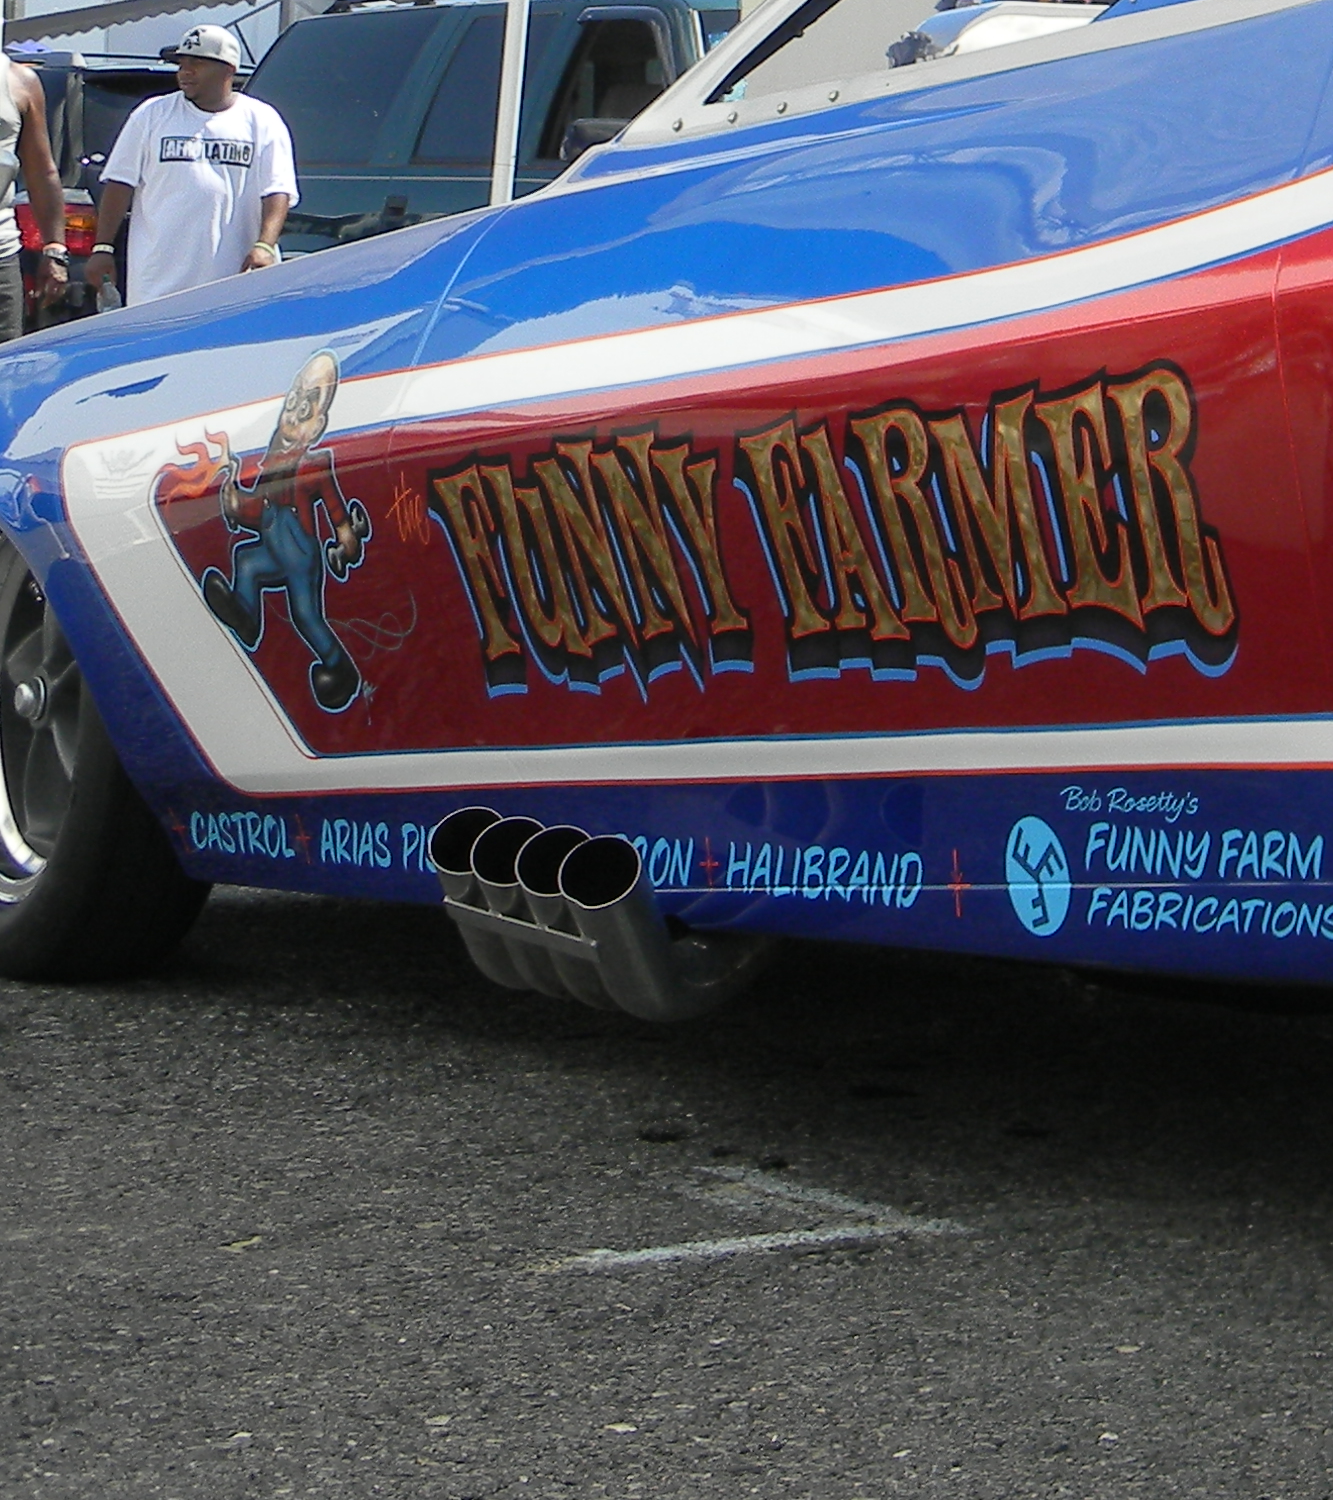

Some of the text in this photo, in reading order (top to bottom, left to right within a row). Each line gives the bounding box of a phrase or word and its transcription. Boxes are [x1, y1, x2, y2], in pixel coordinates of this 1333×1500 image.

[428, 425, 755, 703] FUNNY
[734, 358, 1240, 690] FARMER
[1059, 785, 1102, 812] Bob
[189, 810, 296, 859] CASTROL
[320, 818, 392, 869] ARIAS
[726, 840, 924, 909] HALIBRAND
[1084, 821, 1325, 881] FUNNY FARM
